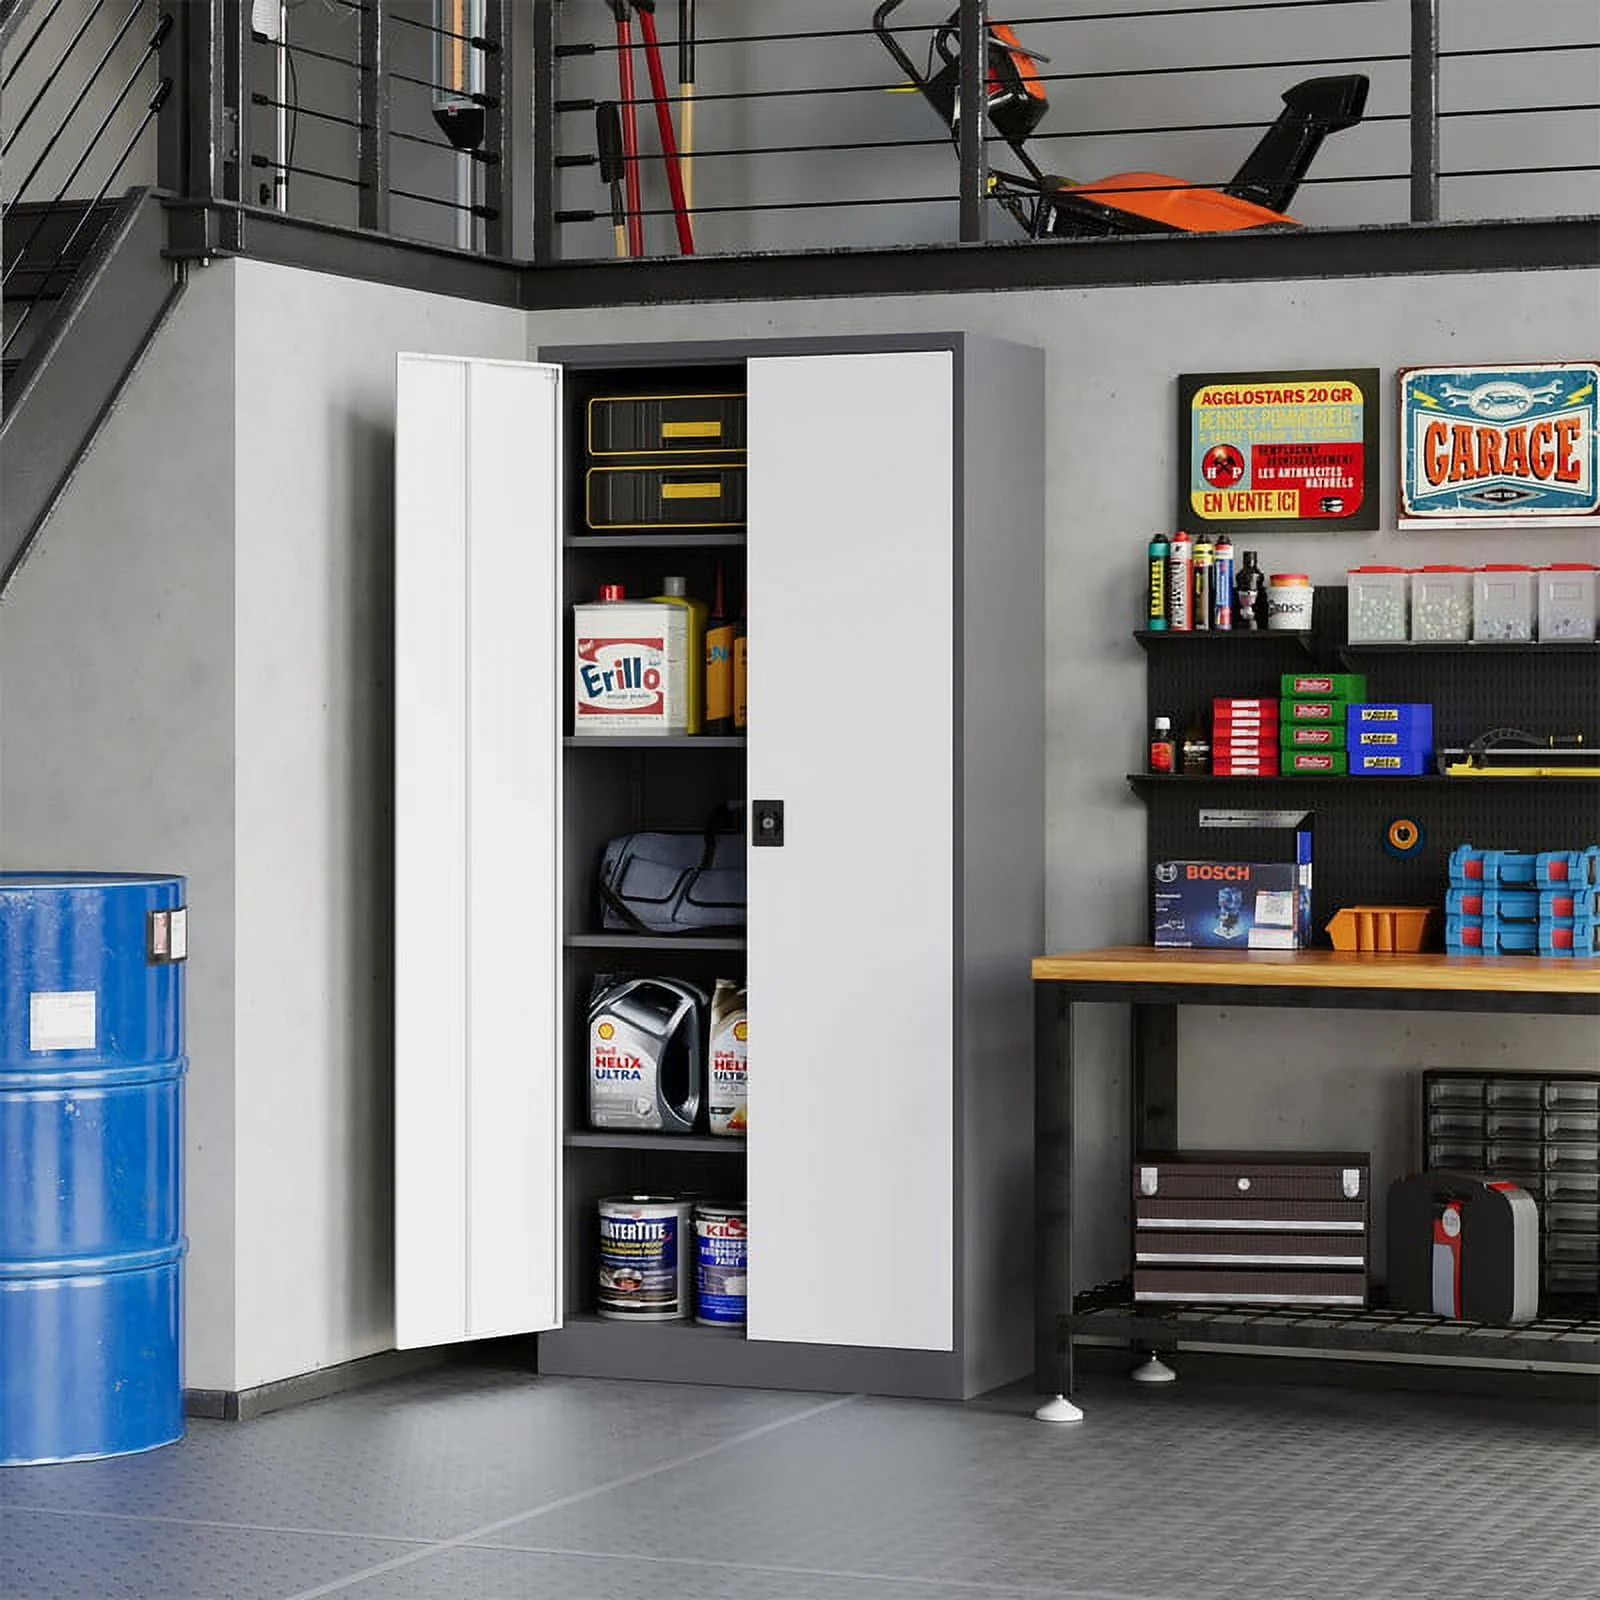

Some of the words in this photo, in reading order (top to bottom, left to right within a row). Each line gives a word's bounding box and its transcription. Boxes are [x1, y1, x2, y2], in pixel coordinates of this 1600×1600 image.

[1201, 390, 1305, 405] AGGLOSTARS
[1308, 388, 1328, 403] 20
[1330, 388, 1353, 402] GR
[1424, 416, 1581, 486] GARAGE
[1232, 467, 1242, 479] P
[1203, 493, 1223, 512] EN
[1227, 492, 1273, 512] VENTE
[1277, 491, 1297, 511] ICI
[580, 656, 661, 698] Erillo
[1186, 865, 1250, 880] BOSCH
[595, 1056, 641, 1068] HELIX
[714, 1060, 748, 1071] HELI
[595, 1069, 641, 1080] ULTRA
